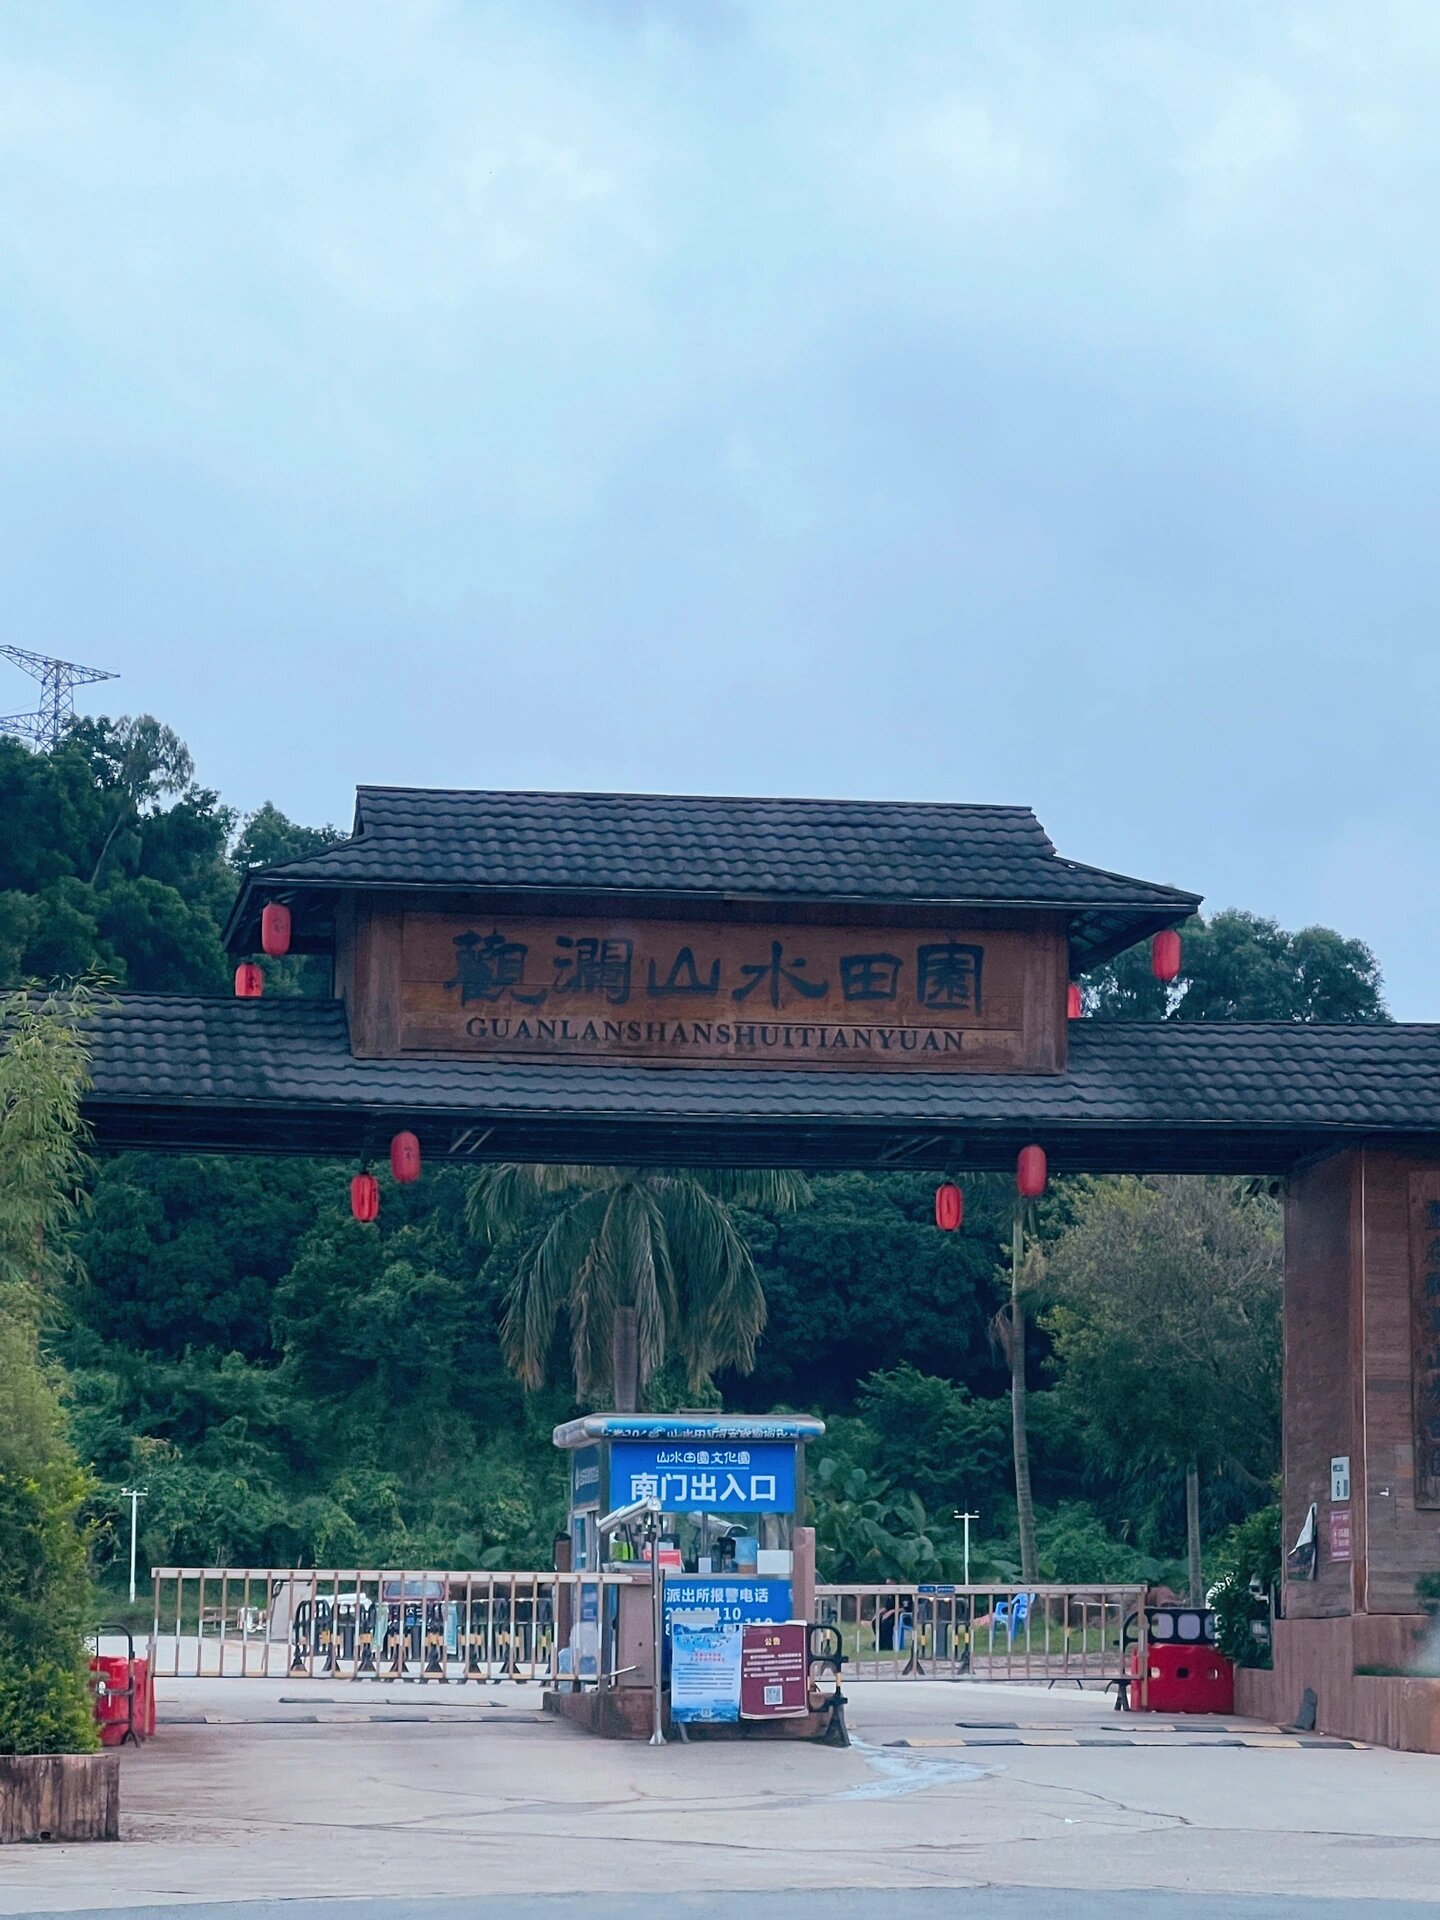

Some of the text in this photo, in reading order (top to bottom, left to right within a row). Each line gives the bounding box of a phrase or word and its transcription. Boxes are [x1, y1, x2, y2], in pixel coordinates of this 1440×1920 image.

[466, 1017, 963, 1051] GUANLANSHANSHUITIANYUAN
[630, 1472, 776, 1502] 南门出入口
[663, 1588, 769, 1603] 派出所报警电话
